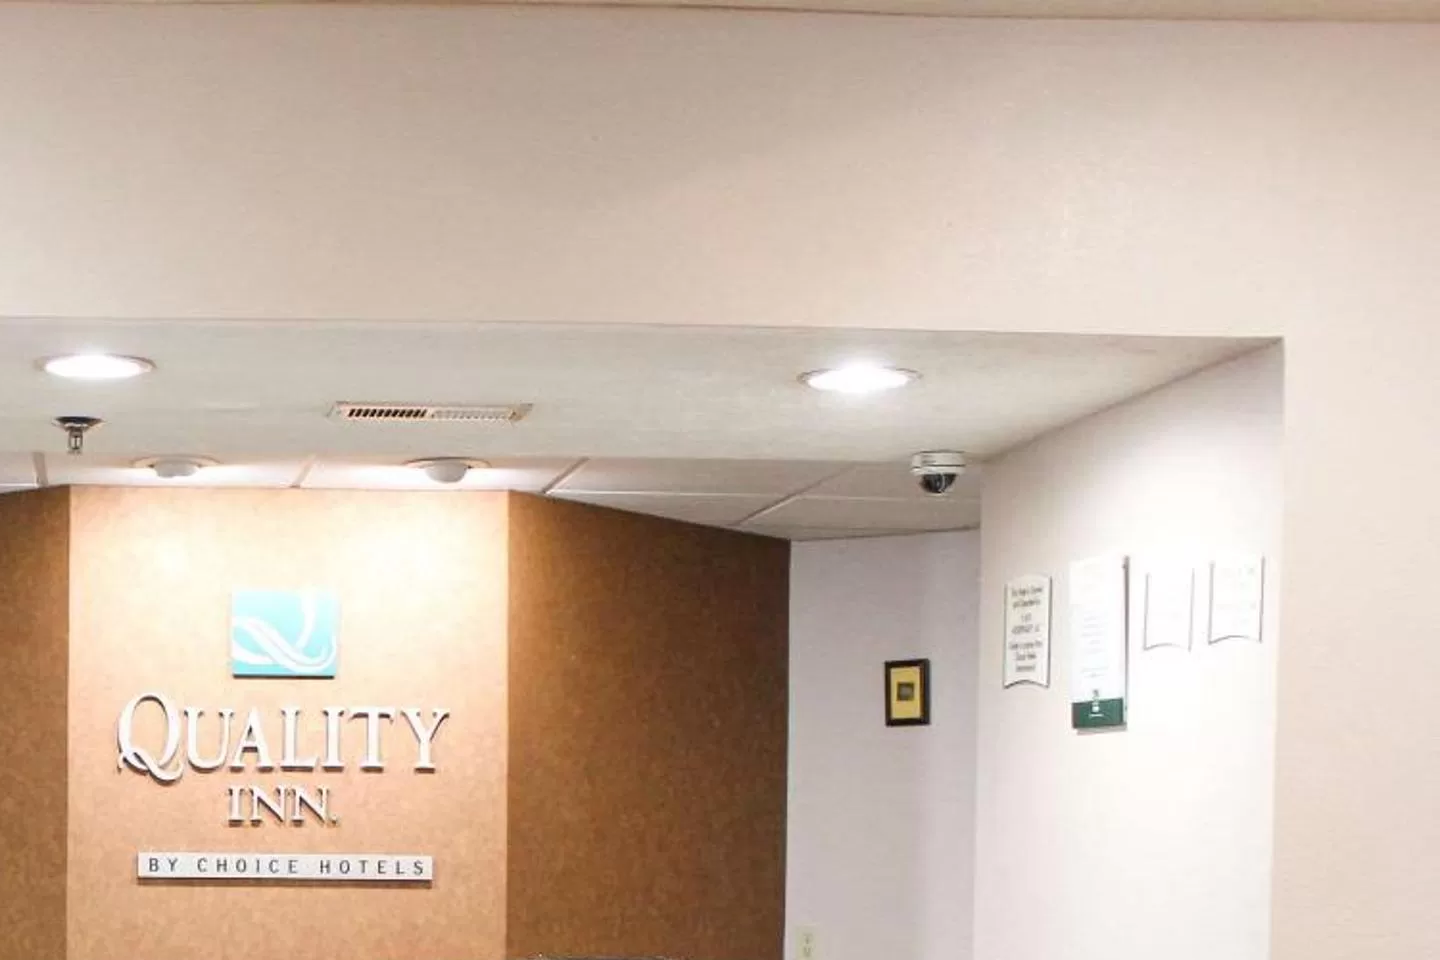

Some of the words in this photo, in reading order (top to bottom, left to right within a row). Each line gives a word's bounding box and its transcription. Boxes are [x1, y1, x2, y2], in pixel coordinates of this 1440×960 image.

[117, 692, 449, 785] QUALITY
[148, 858, 178, 873] BY
[197, 858, 299, 874] CHOICE
[319, 860, 424, 875] HOTELS
